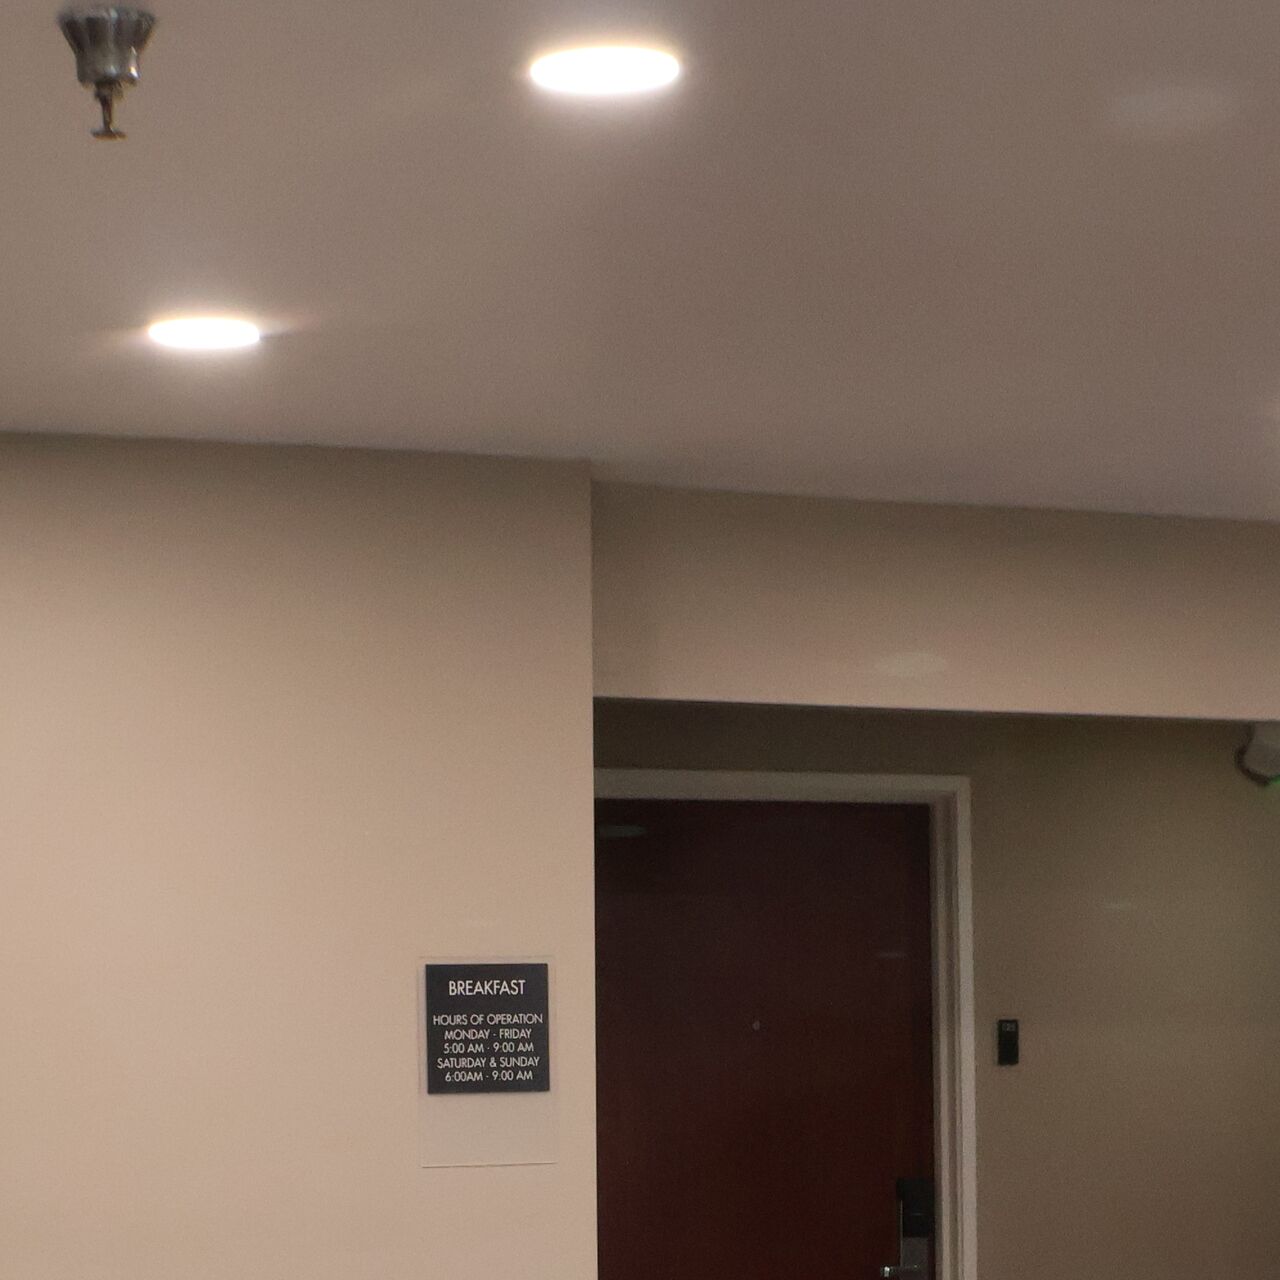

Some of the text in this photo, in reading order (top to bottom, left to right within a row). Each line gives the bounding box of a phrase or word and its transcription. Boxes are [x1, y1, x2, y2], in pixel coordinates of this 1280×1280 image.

[448, 980, 526, 996] BREAKFAST
[433, 1013, 543, 1025] HOURS OF OPERATION
[444, 1029, 490, 1040] MONDAY
[499, 1028, 532, 1039] FRIDAY
[443, 1043, 465, 1054] 5:00
[467, 1043, 484, 1053] AM
[493, 1042, 515, 1053] 9:00
[517, 1042, 534, 1052] AM
[437, 1056, 540, 1069] SATURDAY & SUNDAY
[445, 1071, 483, 1082] 6:00AM
[492, 1070, 514, 1081] 9:00
[516, 1070, 533, 1080] AM
